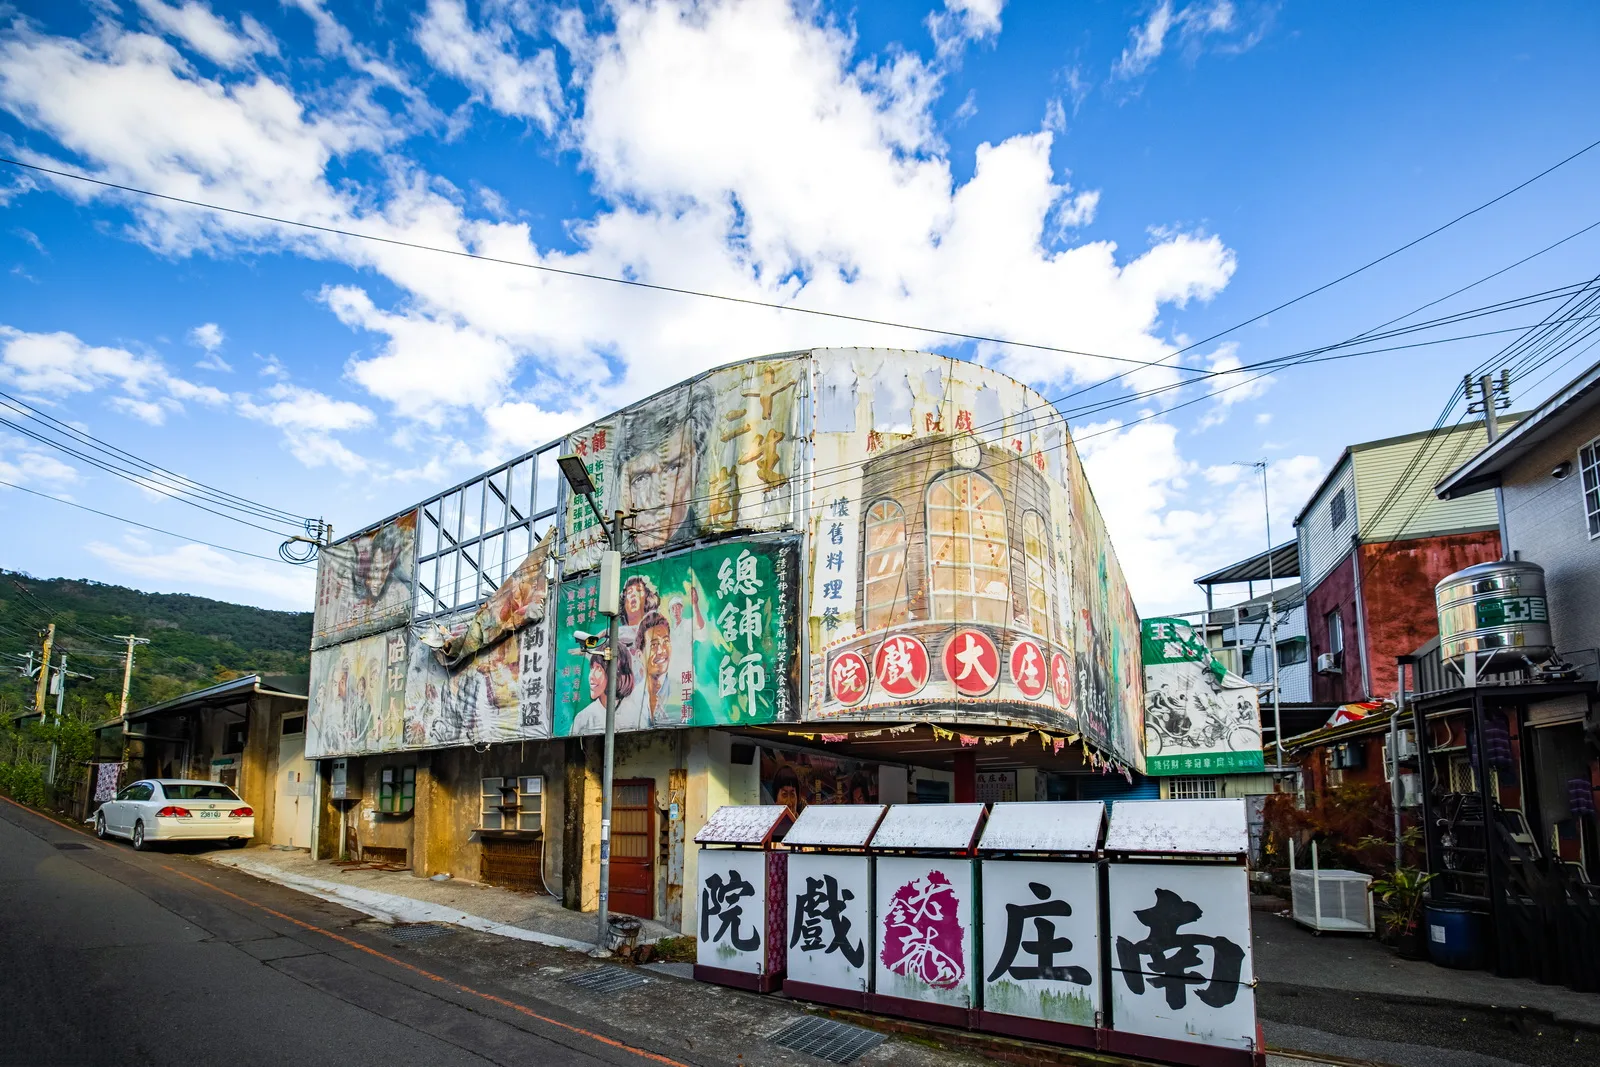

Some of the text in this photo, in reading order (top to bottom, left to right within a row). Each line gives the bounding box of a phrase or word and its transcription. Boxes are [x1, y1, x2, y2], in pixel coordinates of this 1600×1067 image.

[820, 496, 851, 632] 懷舊料理餐
[521, 625, 545, 728] 勒比海盜
[716, 548, 766, 718] 總舖師
